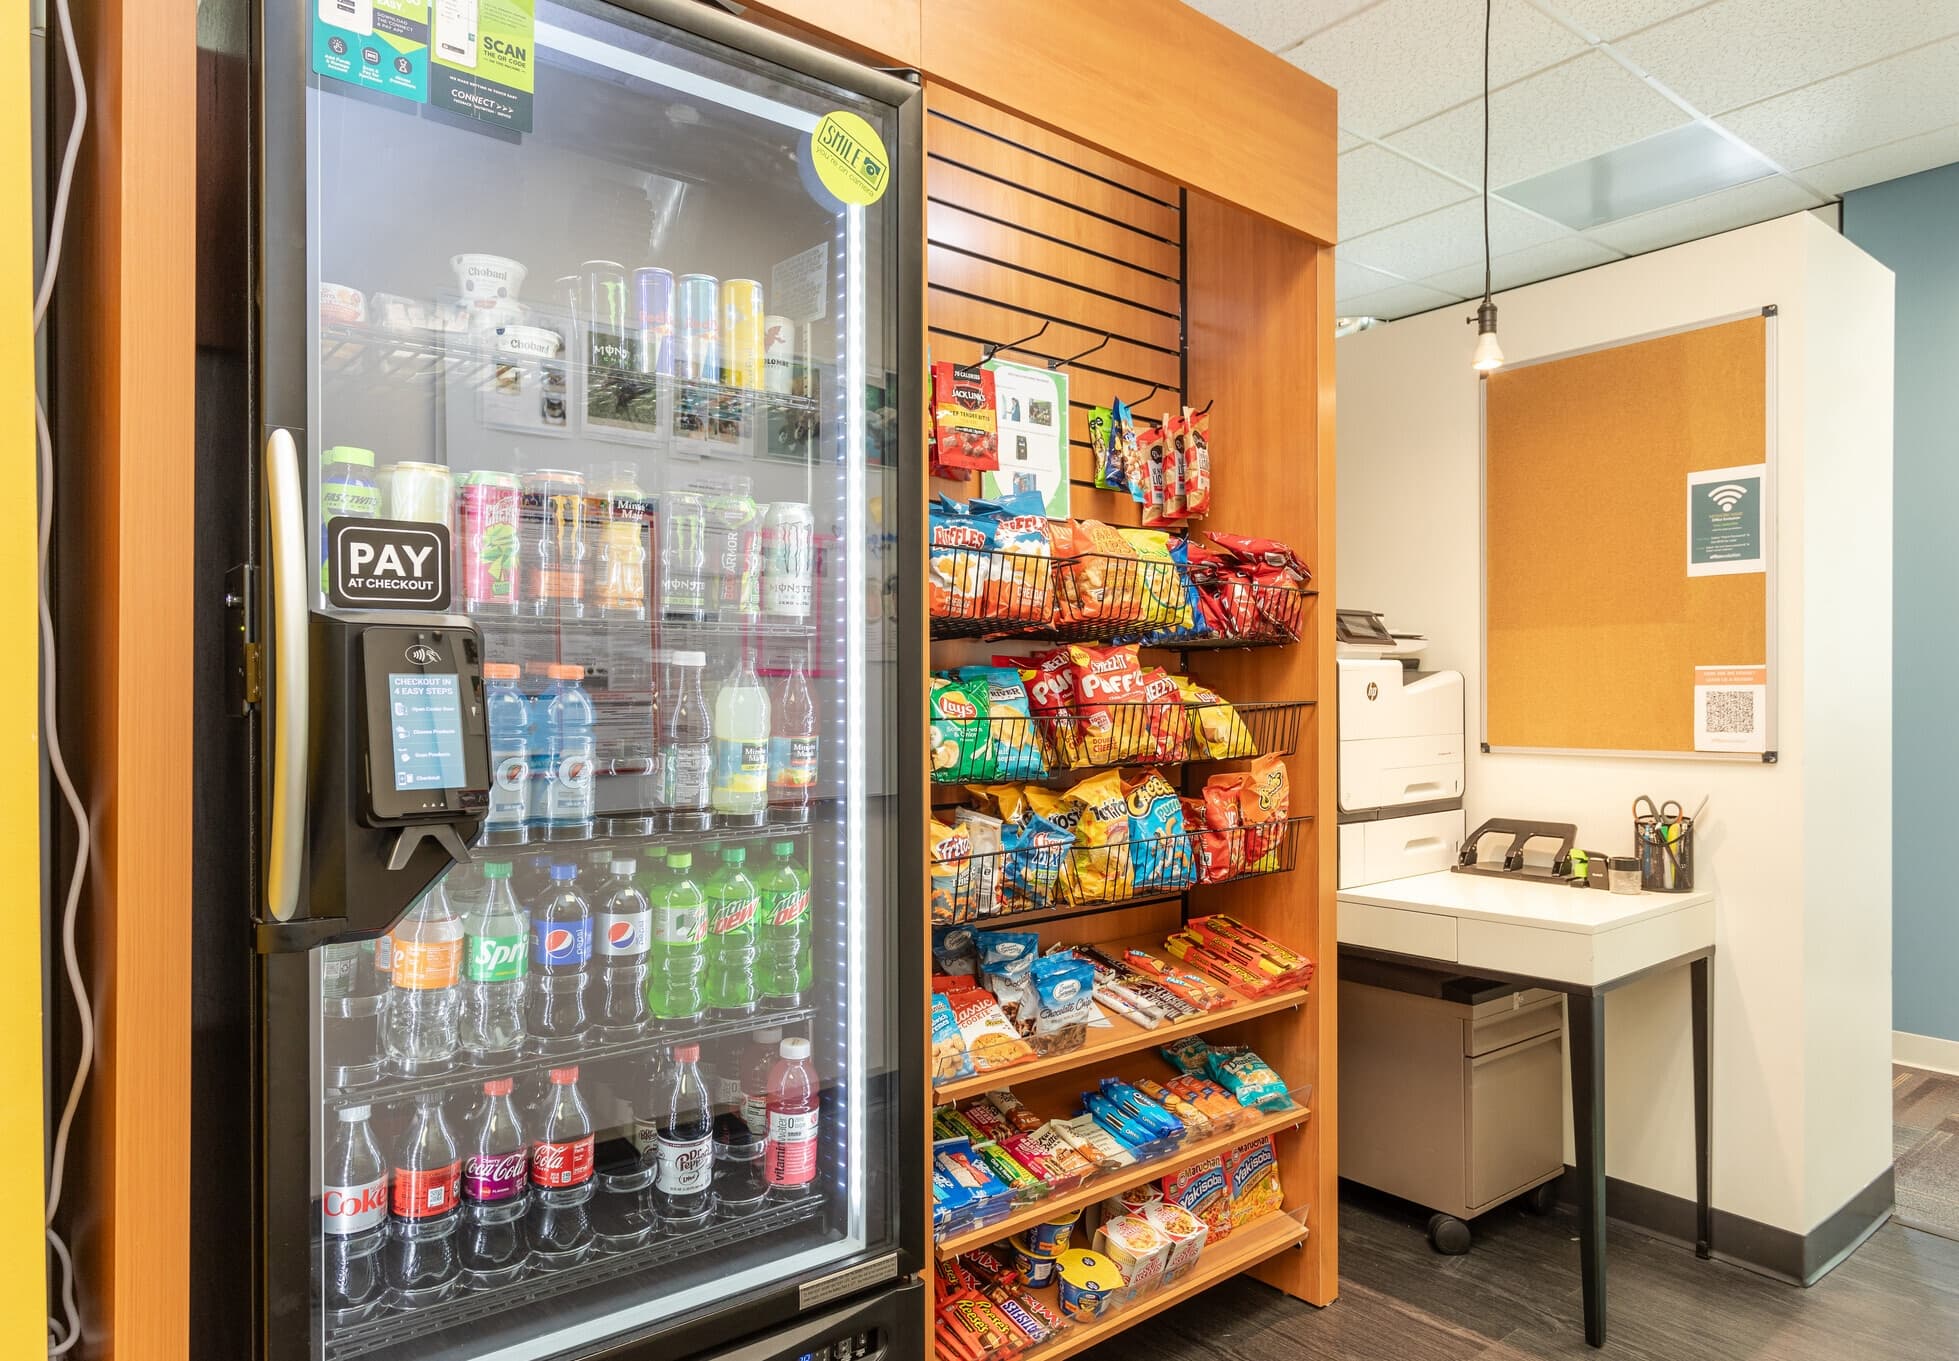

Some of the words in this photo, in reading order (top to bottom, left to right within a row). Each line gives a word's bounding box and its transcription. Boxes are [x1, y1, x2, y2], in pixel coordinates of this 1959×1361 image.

[483, 36, 526, 62] SCAN
[484, 50, 496, 58] THE
[497, 55, 507, 63] QR
[508, 58, 526, 69] CODE
[451, 89, 496, 109] CONNECT
[823, 125, 863, 169] SMILE
[838, 164, 850, 177] on
[849, 174, 875, 197] camera
[952, 389, 968, 399] JACK
[933, 526, 986, 551] RUFFLES
[349, 541, 433, 578] PAY
[348, 578, 363, 589] AT
[365, 579, 434, 591] CHECKOUT
[394, 677, 440, 686] CHECKOUT
[442, 678, 451, 686] IN
[394, 687, 400, 695] 4
[401, 687, 424, 695] EASY
[426, 687, 454, 695] STEPS
[989, 687, 1020, 698] RIVER
[943, 698, 973, 719] Lay's
[1092, 742, 1119, 753] CHEESE
[952, 998, 993, 1024] lassic
[961, 1009, 991, 1029] COOKIE
[1040, 1002, 1075, 1019] Chocolate
[787, 1117, 795, 1129] 0
[690, 1148, 702, 1158] Dr
[1237, 1135, 1269, 1154] Maruchan
[675, 1153, 705, 1172] Pepp
[1184, 1155, 1221, 1178] Maruchan
[1234, 1149, 1272, 1185] Yakisoba
[1181, 1174, 1222, 1207] Yakisoba
[323, 1186, 388, 1218] Coke
[957, 1300, 989, 1335] Reese's
[977, 1300, 1011, 1335] Reese's
[1003, 1301, 1041, 1340] SATISFIES
